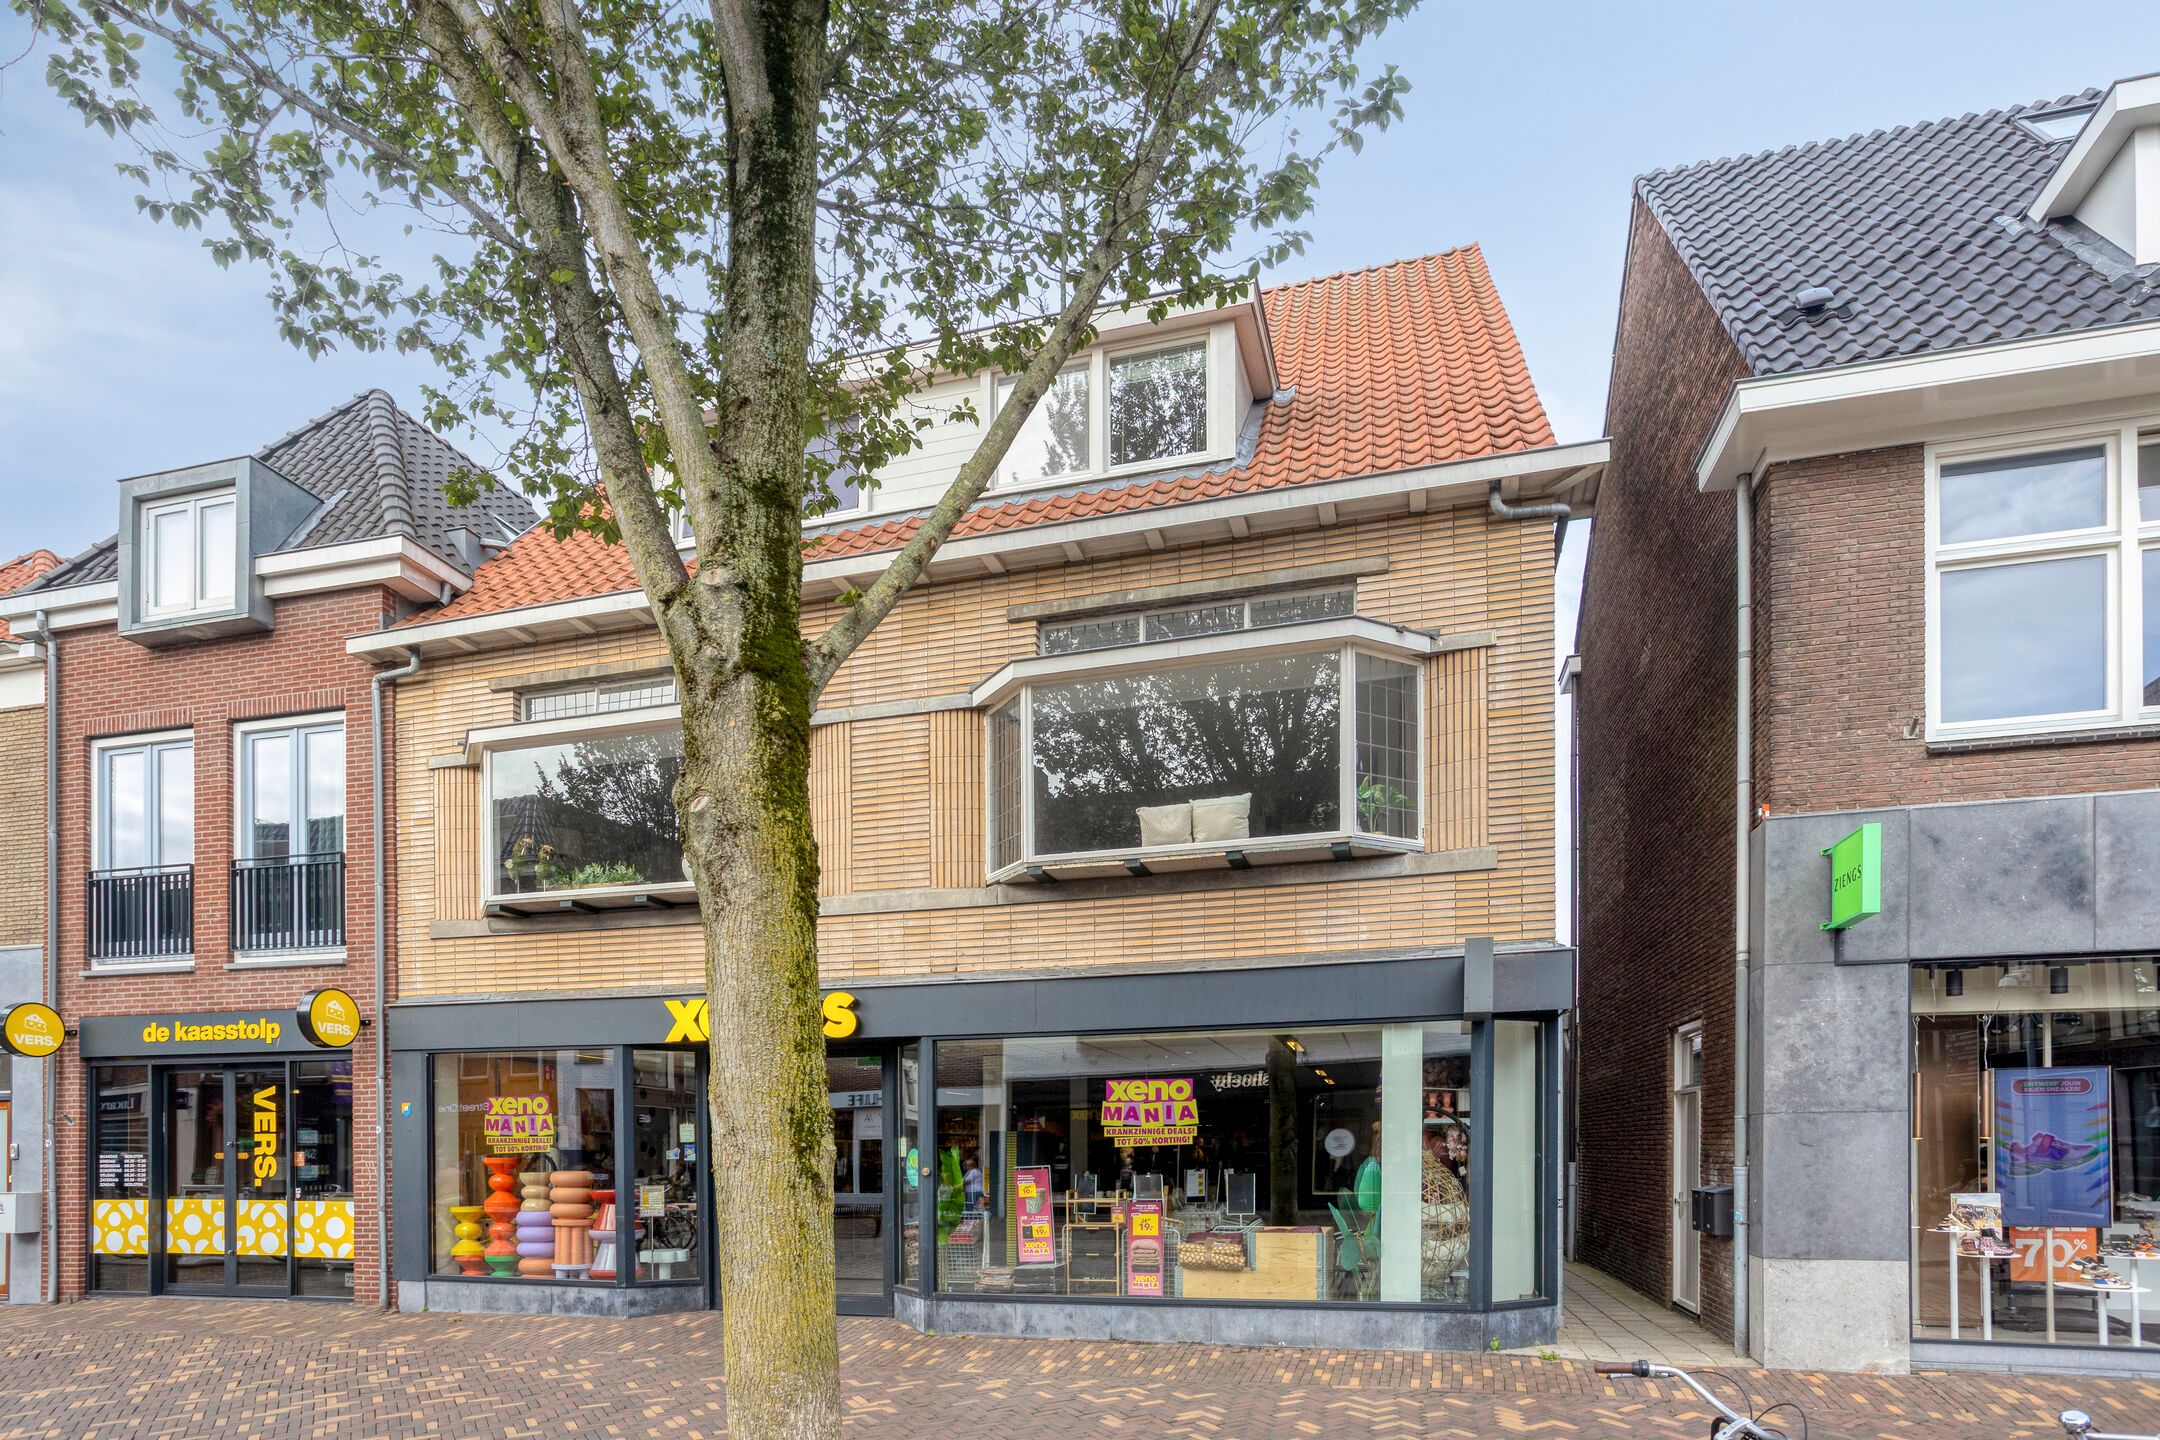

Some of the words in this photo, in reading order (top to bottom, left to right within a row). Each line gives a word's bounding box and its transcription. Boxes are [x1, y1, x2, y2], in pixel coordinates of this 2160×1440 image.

[1834, 864, 1862, 892] ZIENGS
[143, 1022, 170, 1042] de
[174, 1018, 280, 1044] kaasstolp
[317, 1021, 354, 1036] VERS.
[13, 1033, 57, 1047] VERS.
[1108, 1080, 1191, 1101] xeno
[489, 1097, 549, 1115] xeno
[1103, 1105, 1196, 1123] MANIA
[485, 1118, 552, 1134] MANIA
[1106, 1128, 1166, 1136] KRANKZINNIGE
[1167, 1127, 1195, 1135] DEALS!
[253, 1085, 277, 1187] VERS.
[1117, 1138, 1132, 1146] TOT
[1133, 1137, 1151, 1145] 50%
